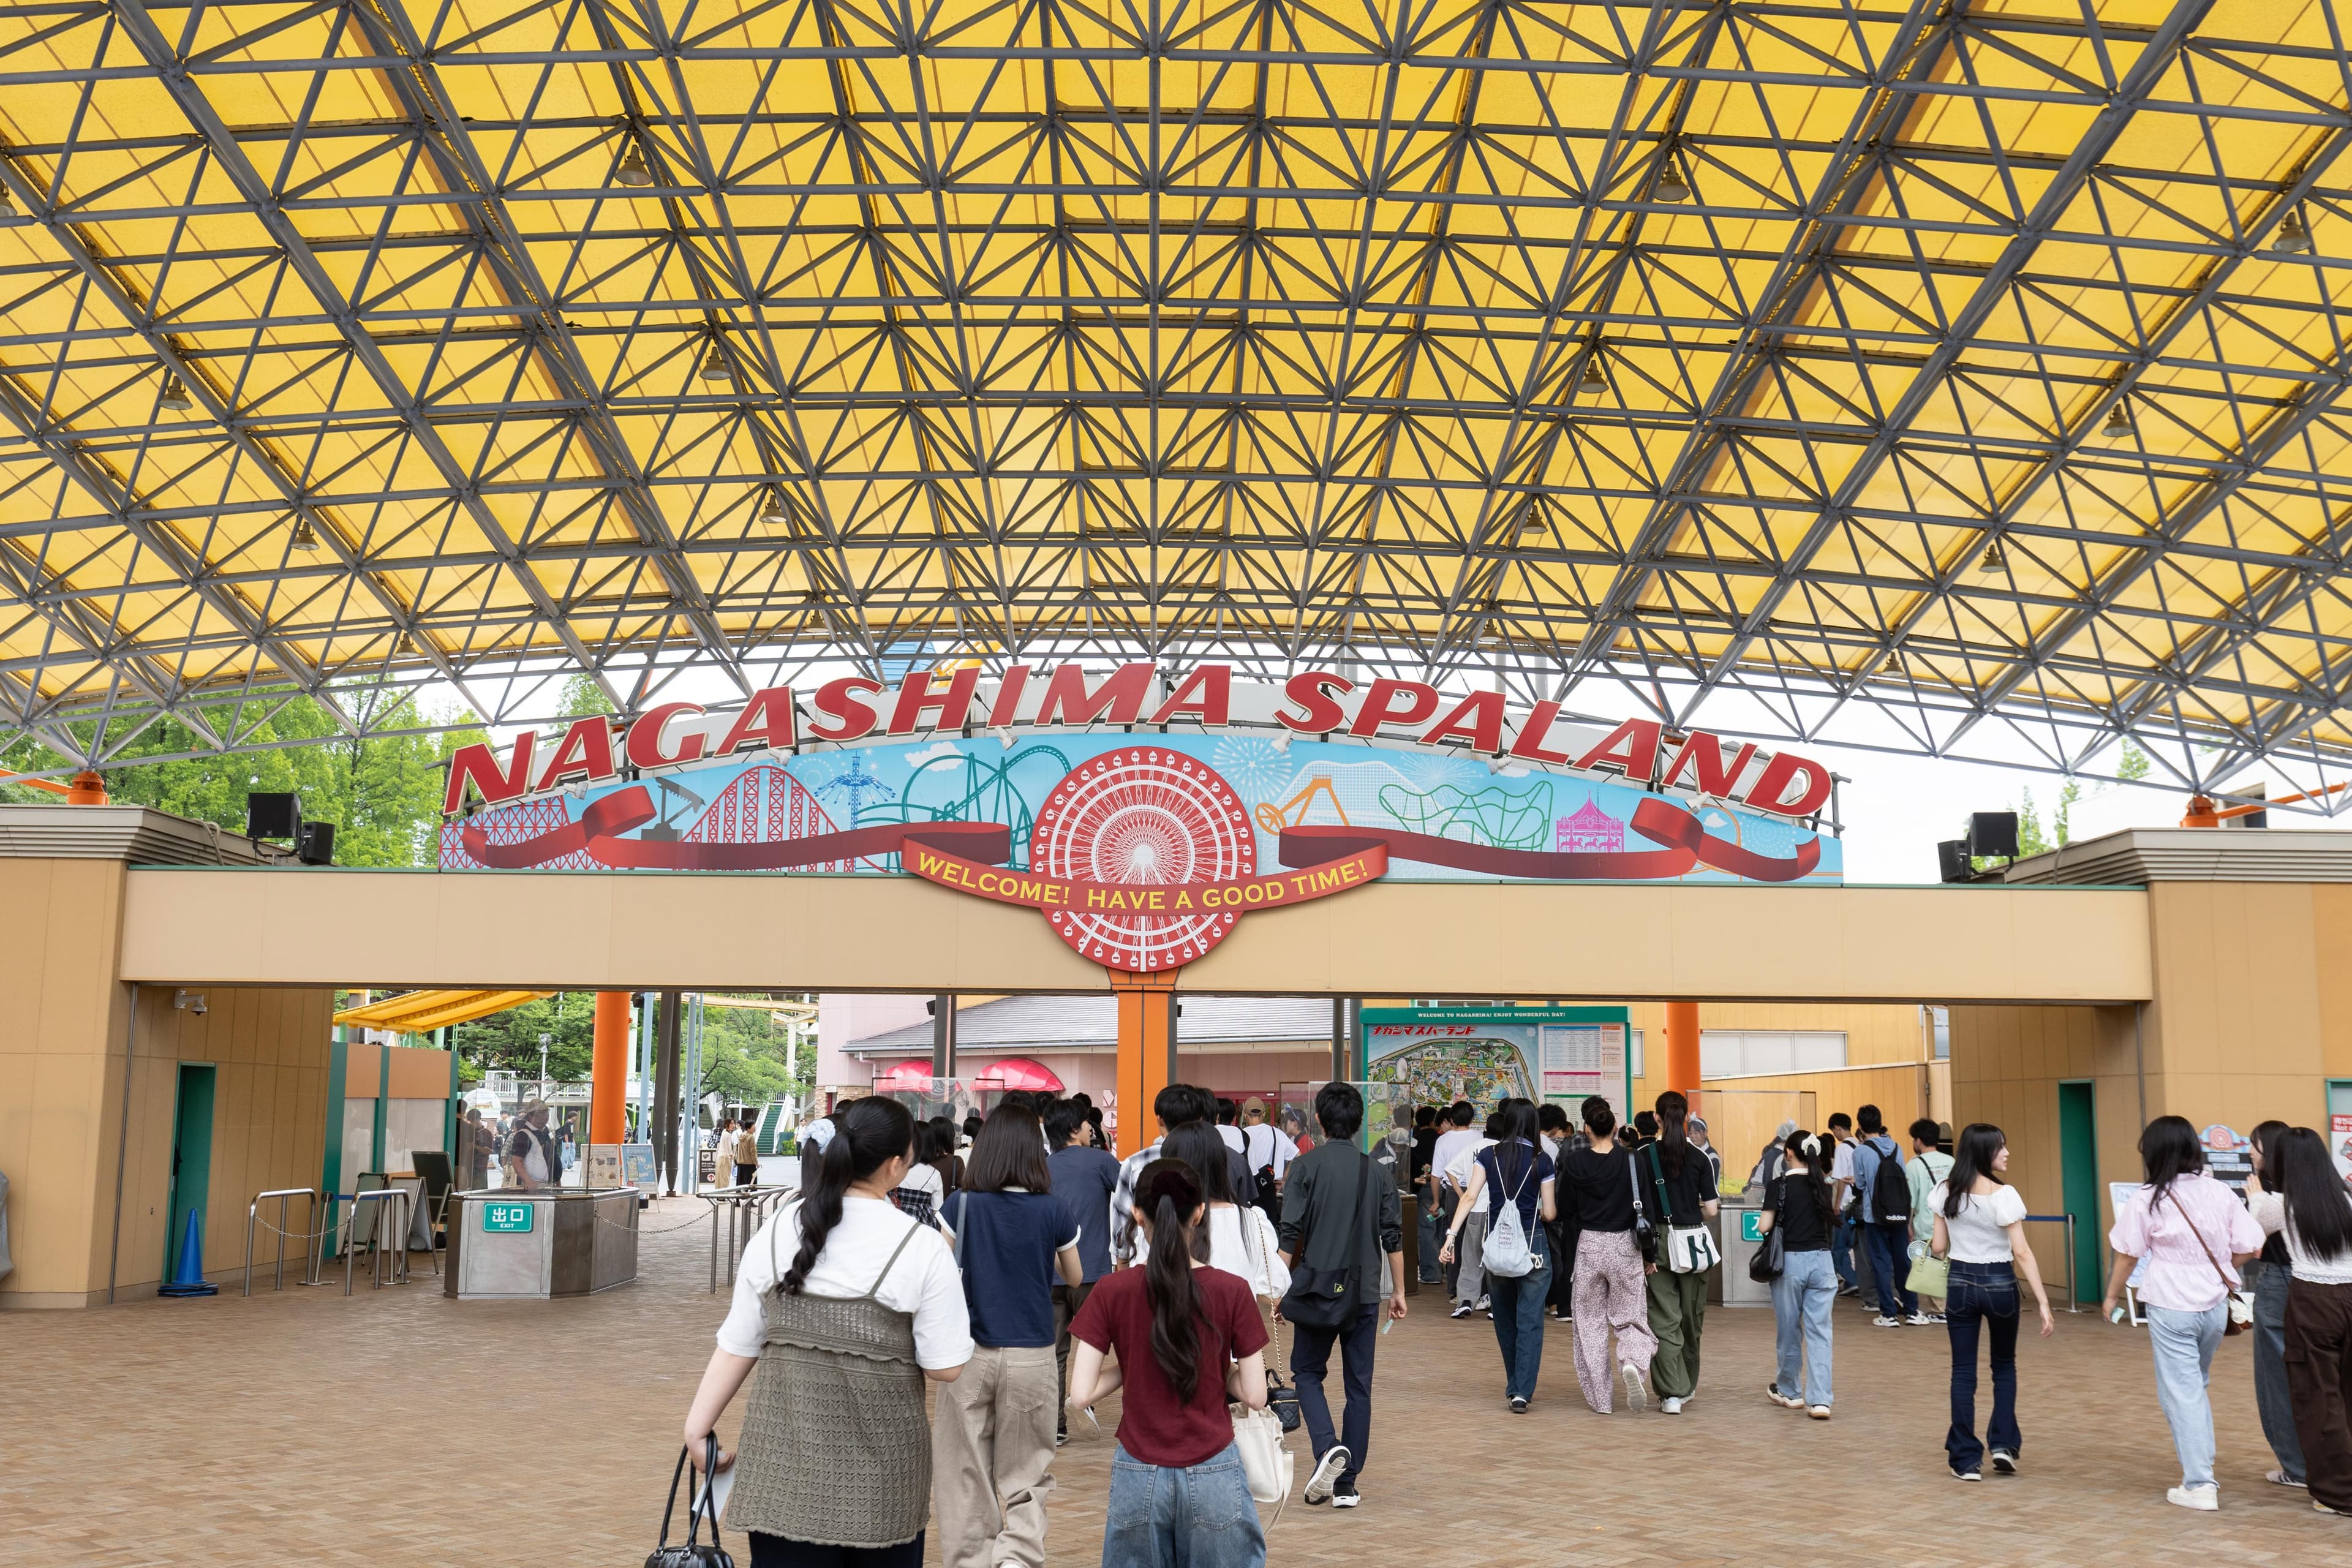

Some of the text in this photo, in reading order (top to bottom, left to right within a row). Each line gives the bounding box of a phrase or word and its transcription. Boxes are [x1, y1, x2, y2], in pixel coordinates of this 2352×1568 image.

[443, 663, 1833, 817] NAGASHIMA SPALAND
[919, 852, 1368, 910] WELCOME! HAVE A GOOD TIME!
[492, 1207, 524, 1222] 出口
